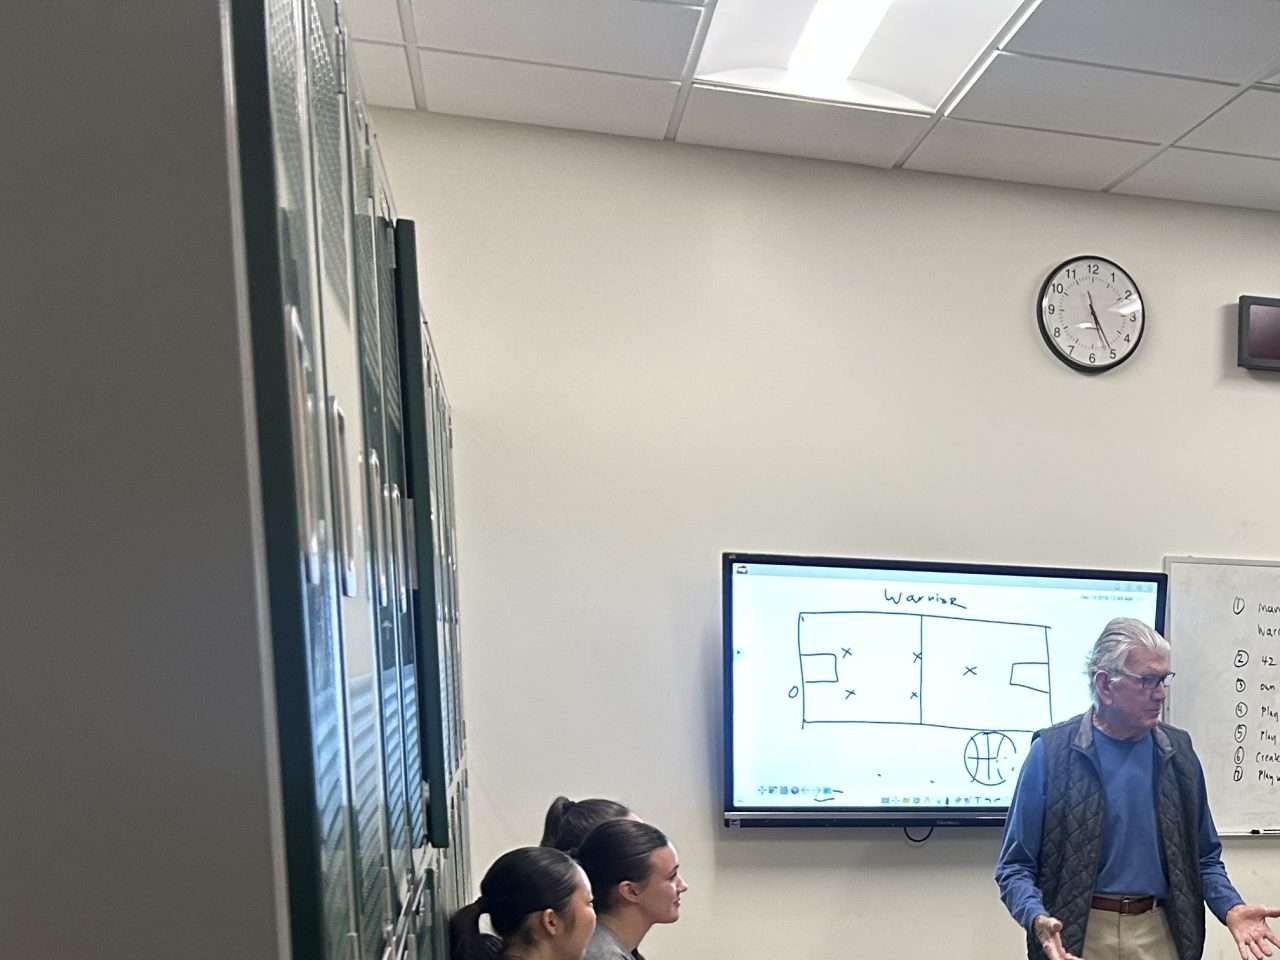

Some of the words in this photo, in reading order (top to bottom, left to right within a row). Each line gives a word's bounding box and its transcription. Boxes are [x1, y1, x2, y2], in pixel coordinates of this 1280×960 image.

[1067, 269, 1077, 279] 11
[1088, 265, 1100, 275] 12
[1110, 273, 1115, 282] 1
[1053, 284, 1064, 294] 10
[1125, 291, 1132, 300] 2
[1048, 305, 1055, 315] 9
[1130, 313, 1137, 323] 3
[1054, 328, 1061, 338] 8
[1123, 334, 1130, 344] 4
[1068, 346, 1075, 356] 7
[1110, 349, 1117, 359] 5
[1089, 353, 1096, 364] 6
